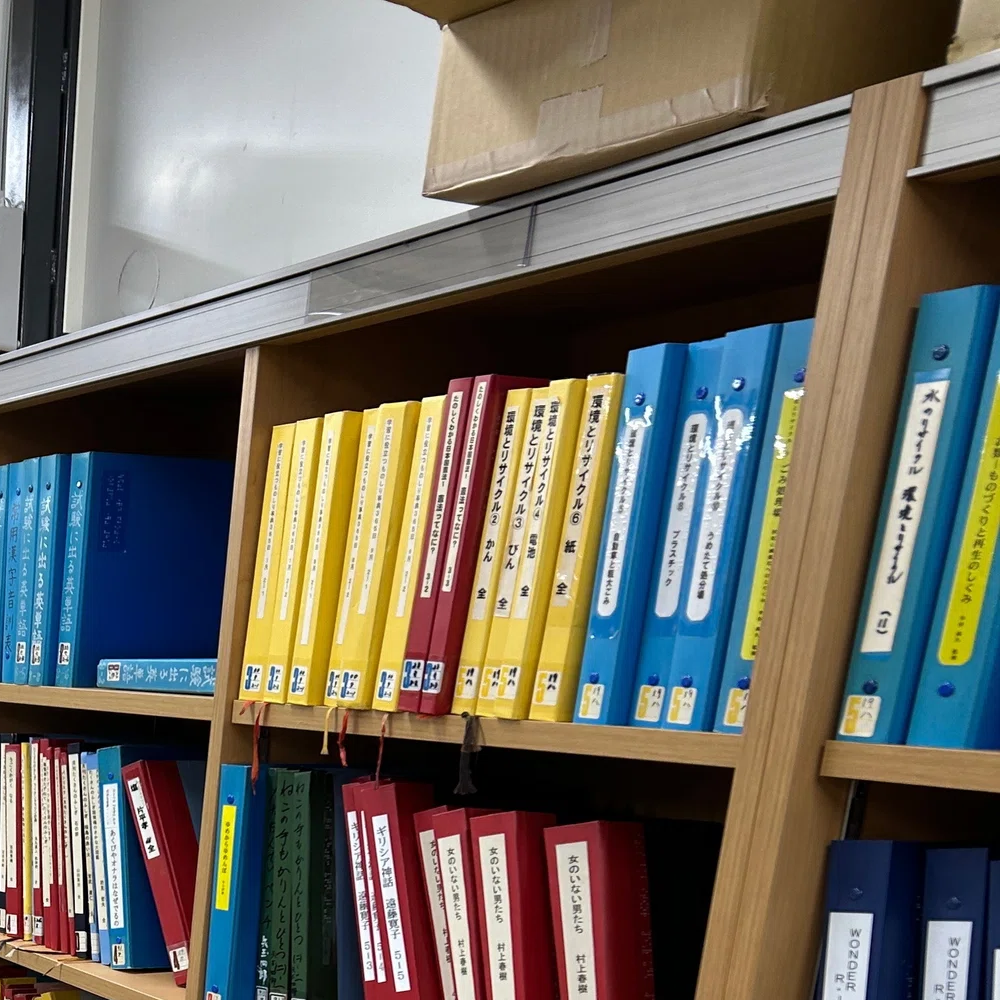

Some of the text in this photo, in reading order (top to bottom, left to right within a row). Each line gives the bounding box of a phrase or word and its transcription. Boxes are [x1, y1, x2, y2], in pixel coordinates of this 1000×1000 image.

[482, 538, 496, 563] かん
[564, 539, 576, 554] 紙
[664, 529, 682, 588] プラスチック
[476, 587, 487, 601] 全
[496, 598, 508, 610] 全
[520, 584, 531, 597] 全
[556, 581, 568, 596] 全
[567, 854, 584, 935] 女のいない男たち
[446, 847, 462, 921] 女のいない男たち
[457, 939, 468, 976] 村上春樹
[488, 846, 504, 924] 女のいない男たち
[496, 942, 508, 981] 村上春樹
[575, 953, 589, 994] 村上春樹
[846, 928, 862, 992] WONDER
